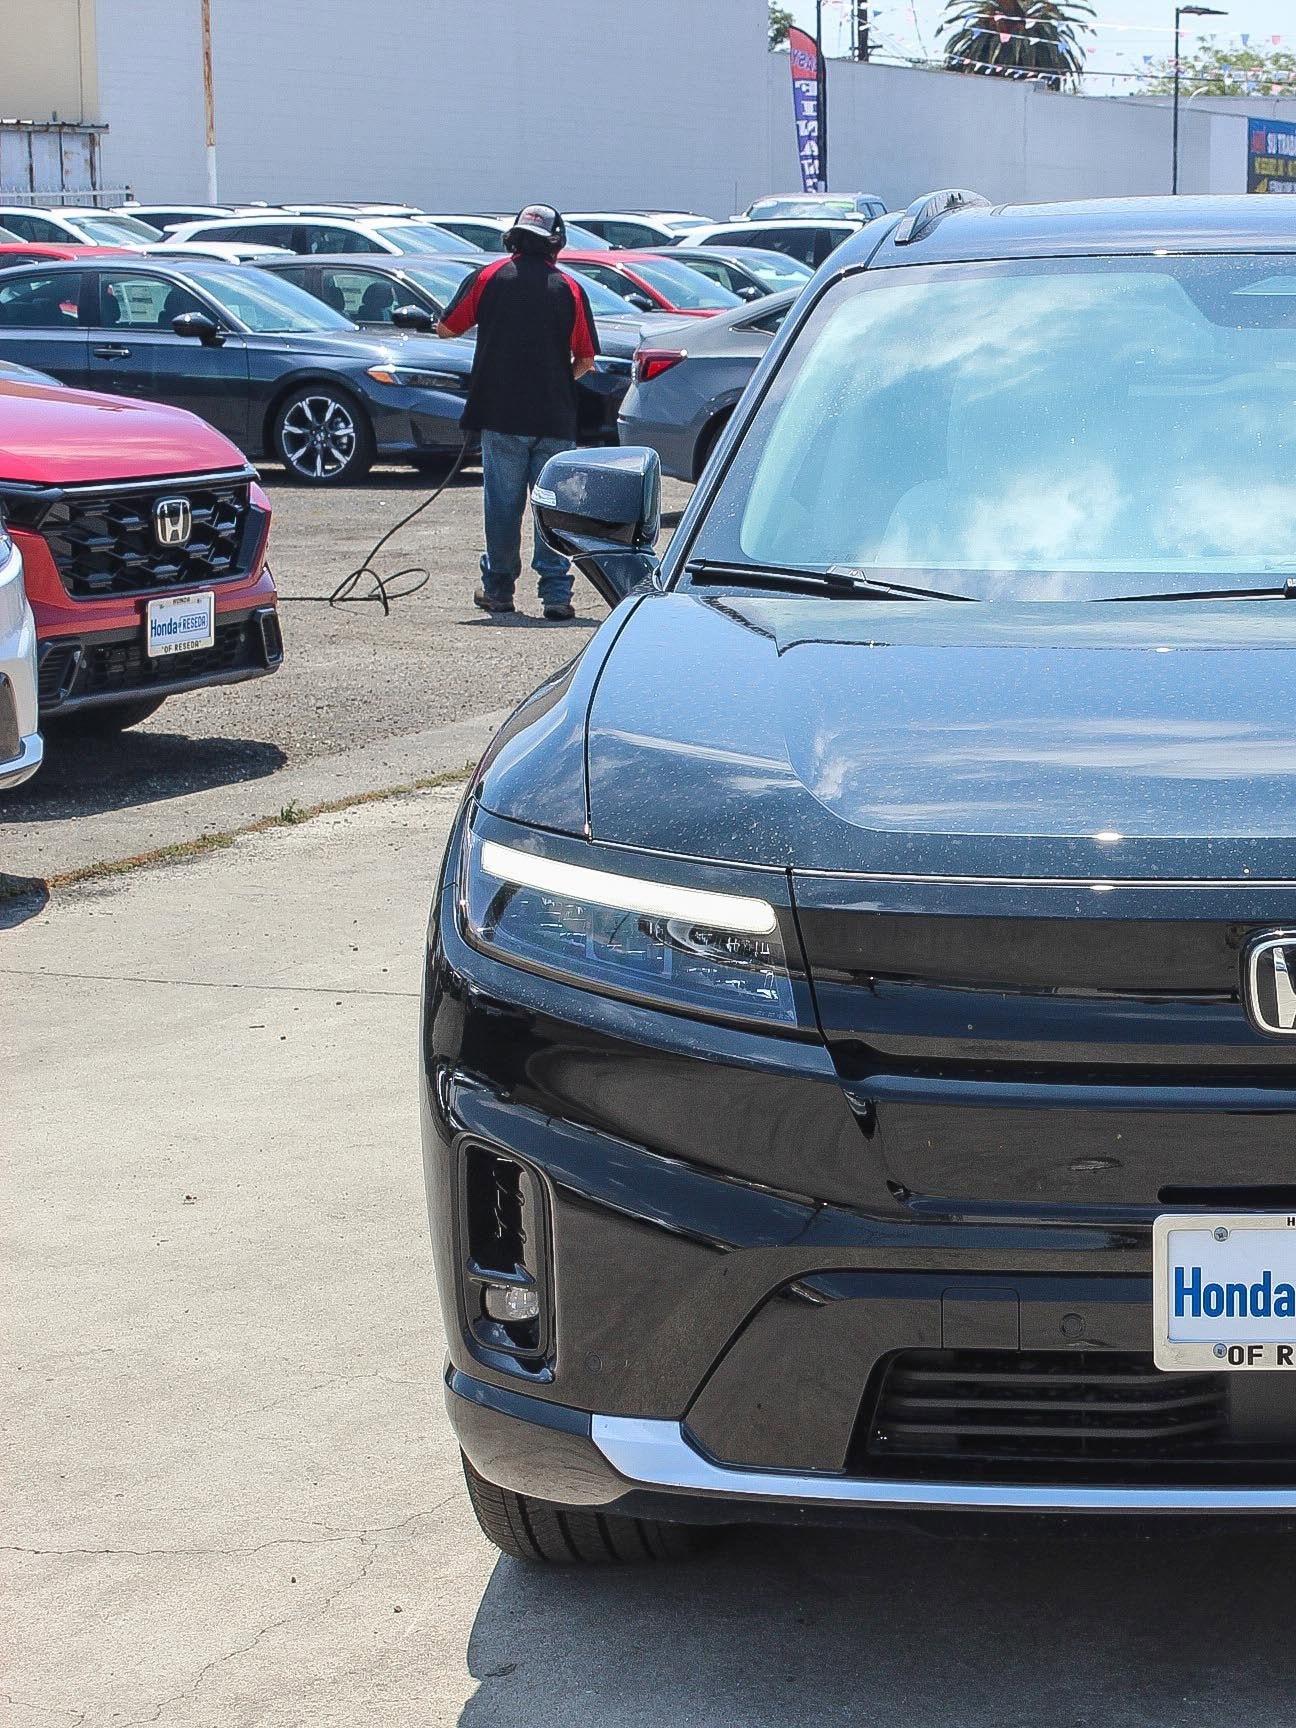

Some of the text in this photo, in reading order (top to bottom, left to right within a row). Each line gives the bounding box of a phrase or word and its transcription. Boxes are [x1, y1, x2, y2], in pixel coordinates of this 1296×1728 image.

[150, 617, 178, 638] Honda
[182, 615, 206, 630] RESEDA
[164, 640, 199, 653] OF RESEDA
[1174, 1266, 1296, 1318] Honda
[1227, 1345, 1264, 1366] OF
